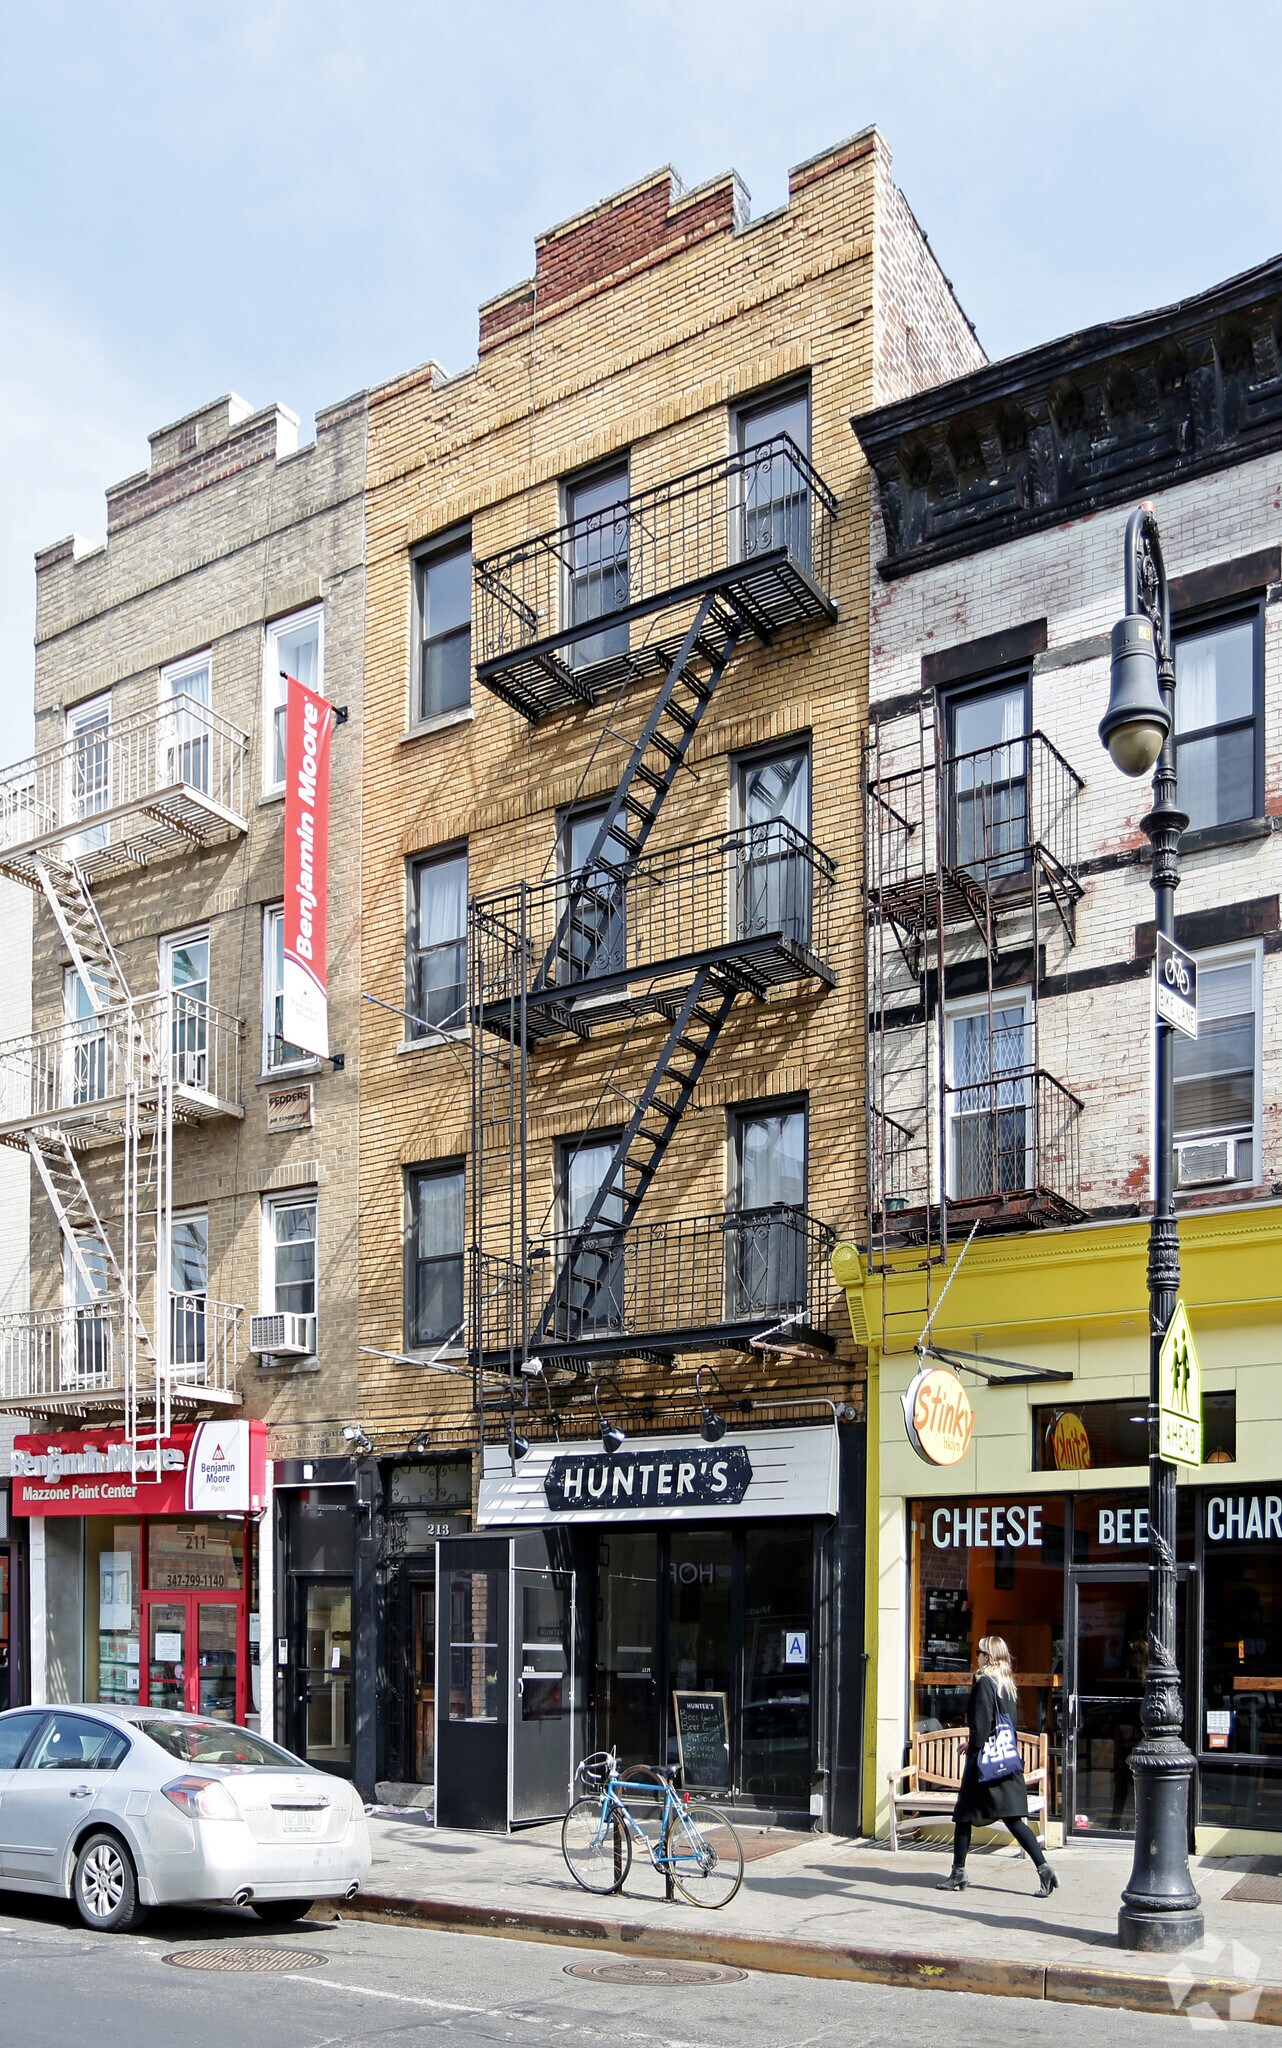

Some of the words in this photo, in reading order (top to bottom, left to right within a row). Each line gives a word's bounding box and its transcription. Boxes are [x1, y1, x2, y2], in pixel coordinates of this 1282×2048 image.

[298, 704, 318, 807] Moore
[296, 812, 317, 960] Benjamin
[1160, 989, 1174, 1014] BIKE
[1177, 1000, 1194, 1029] LANE
[269, 1091, 308, 1107] FEDDERS
[914, 1385, 976, 1452] Stinky
[1165, 1420, 1196, 1455] AHEAD
[10, 1445, 99, 1484] Benjamin
[201, 1462, 235, 1475] Benjamin
[206, 1474, 230, 1484] Moore
[563, 1461, 729, 1498] HUNTER'S
[22, 1486, 70, 1501] Mazzone
[72, 1485, 99, 1499] Paint
[101, 1483, 138, 1499] Center
[427, 1523, 450, 1536] 213
[932, 1505, 1043, 1549] CHEESE
[1099, 1508, 1148, 1543] BEE
[186, 1535, 206, 1549] 211
[167, 1574, 224, 1588] 347-799-1140
[789, 1636, 802, 1654] A
[680, 1709, 699, 1720] Beer
[681, 1720, 700, 1731] Beer
[686, 1743, 716, 1752] Service
